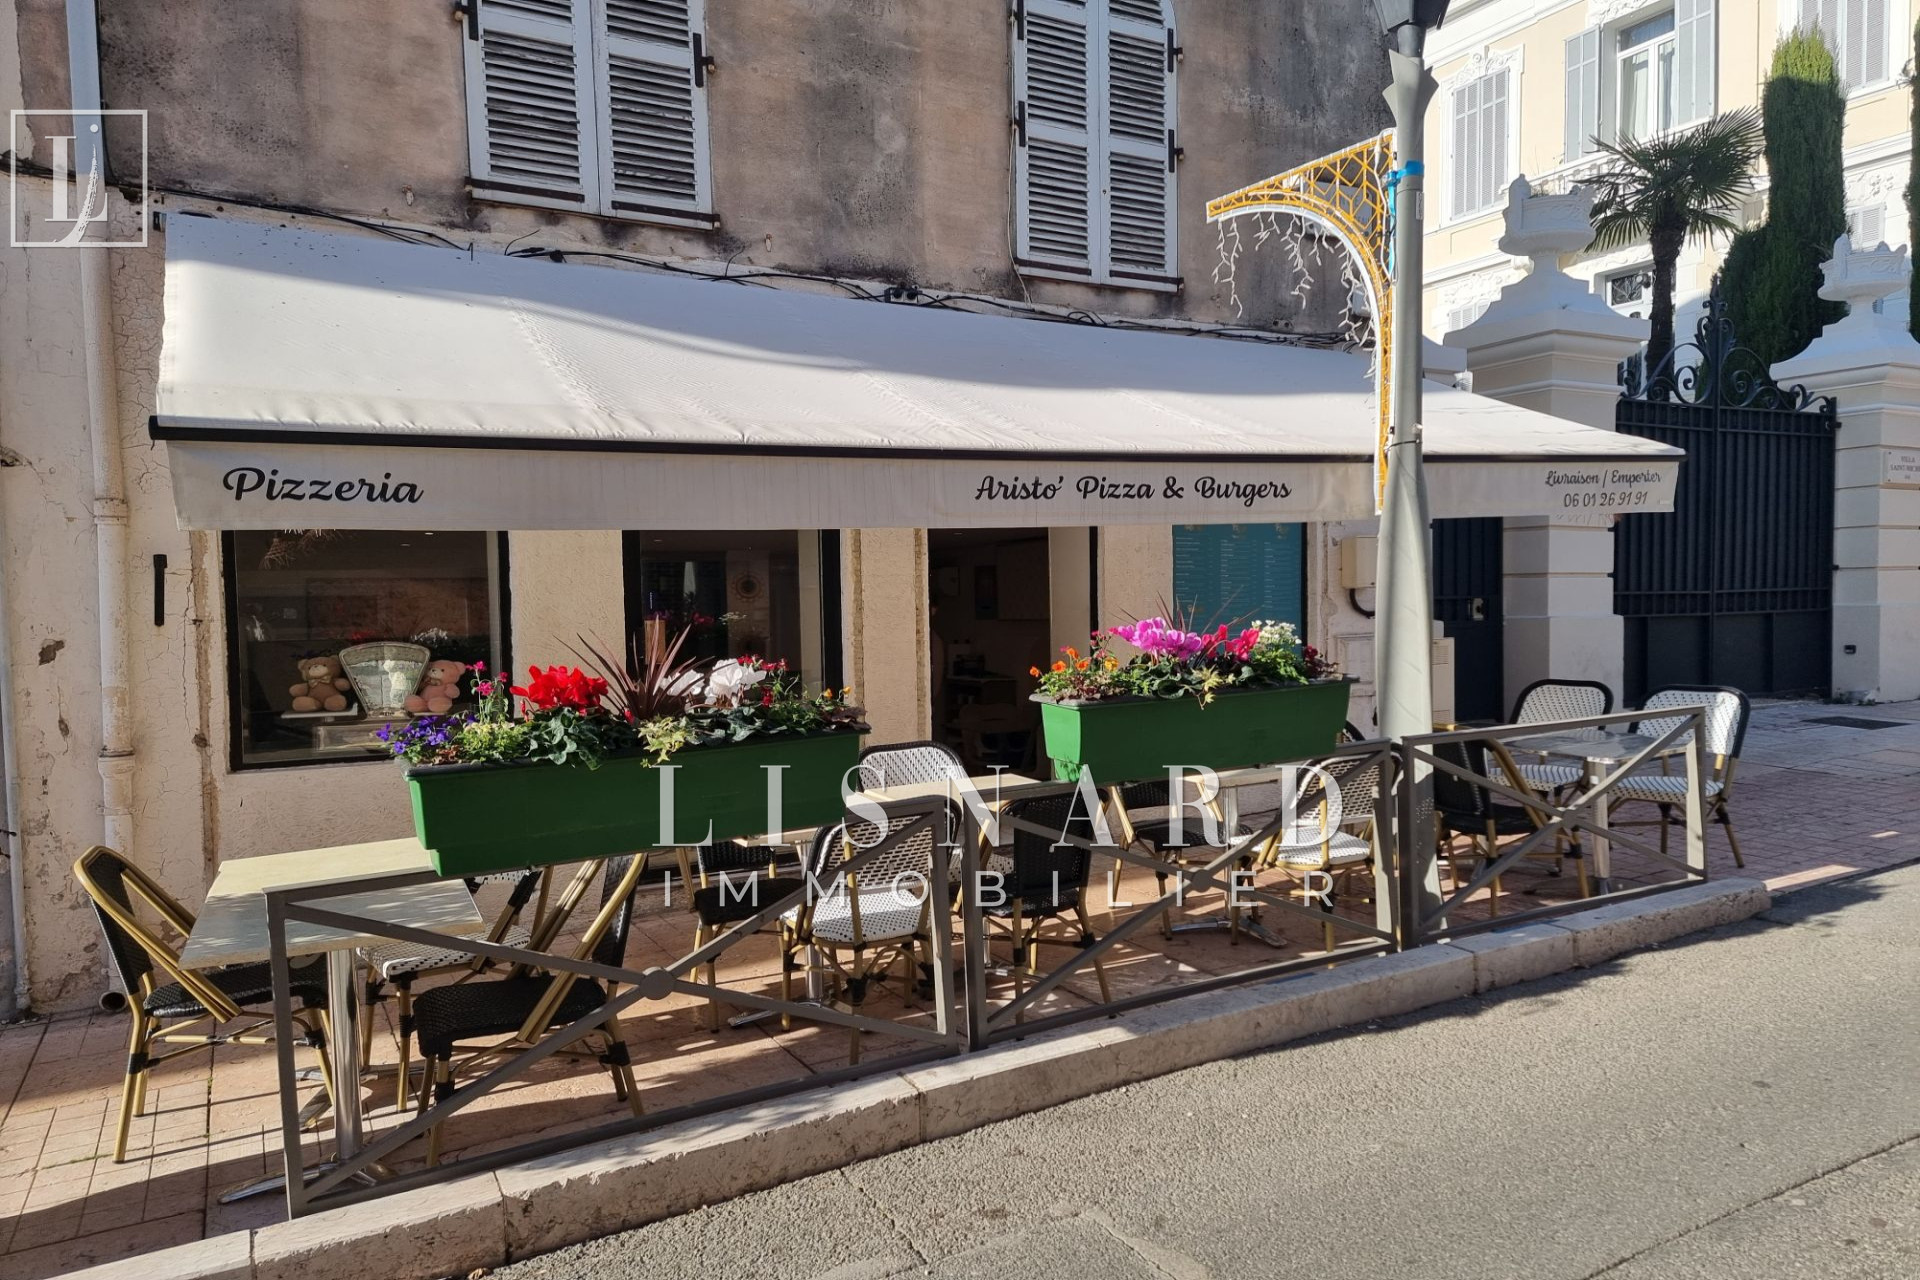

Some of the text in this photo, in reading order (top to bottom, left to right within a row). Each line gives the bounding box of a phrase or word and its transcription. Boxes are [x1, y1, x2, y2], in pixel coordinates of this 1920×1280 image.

[222, 467, 424, 503] Pizzeria
[1076, 475, 1155, 499] Pizza
[1163, 476, 1185, 499] &
[1194, 476, 1292, 507] Burgers
[1545, 469, 1662, 488] Livraison / Emporter
[1564, 490, 1649, 508] 06 01 26 91 91
